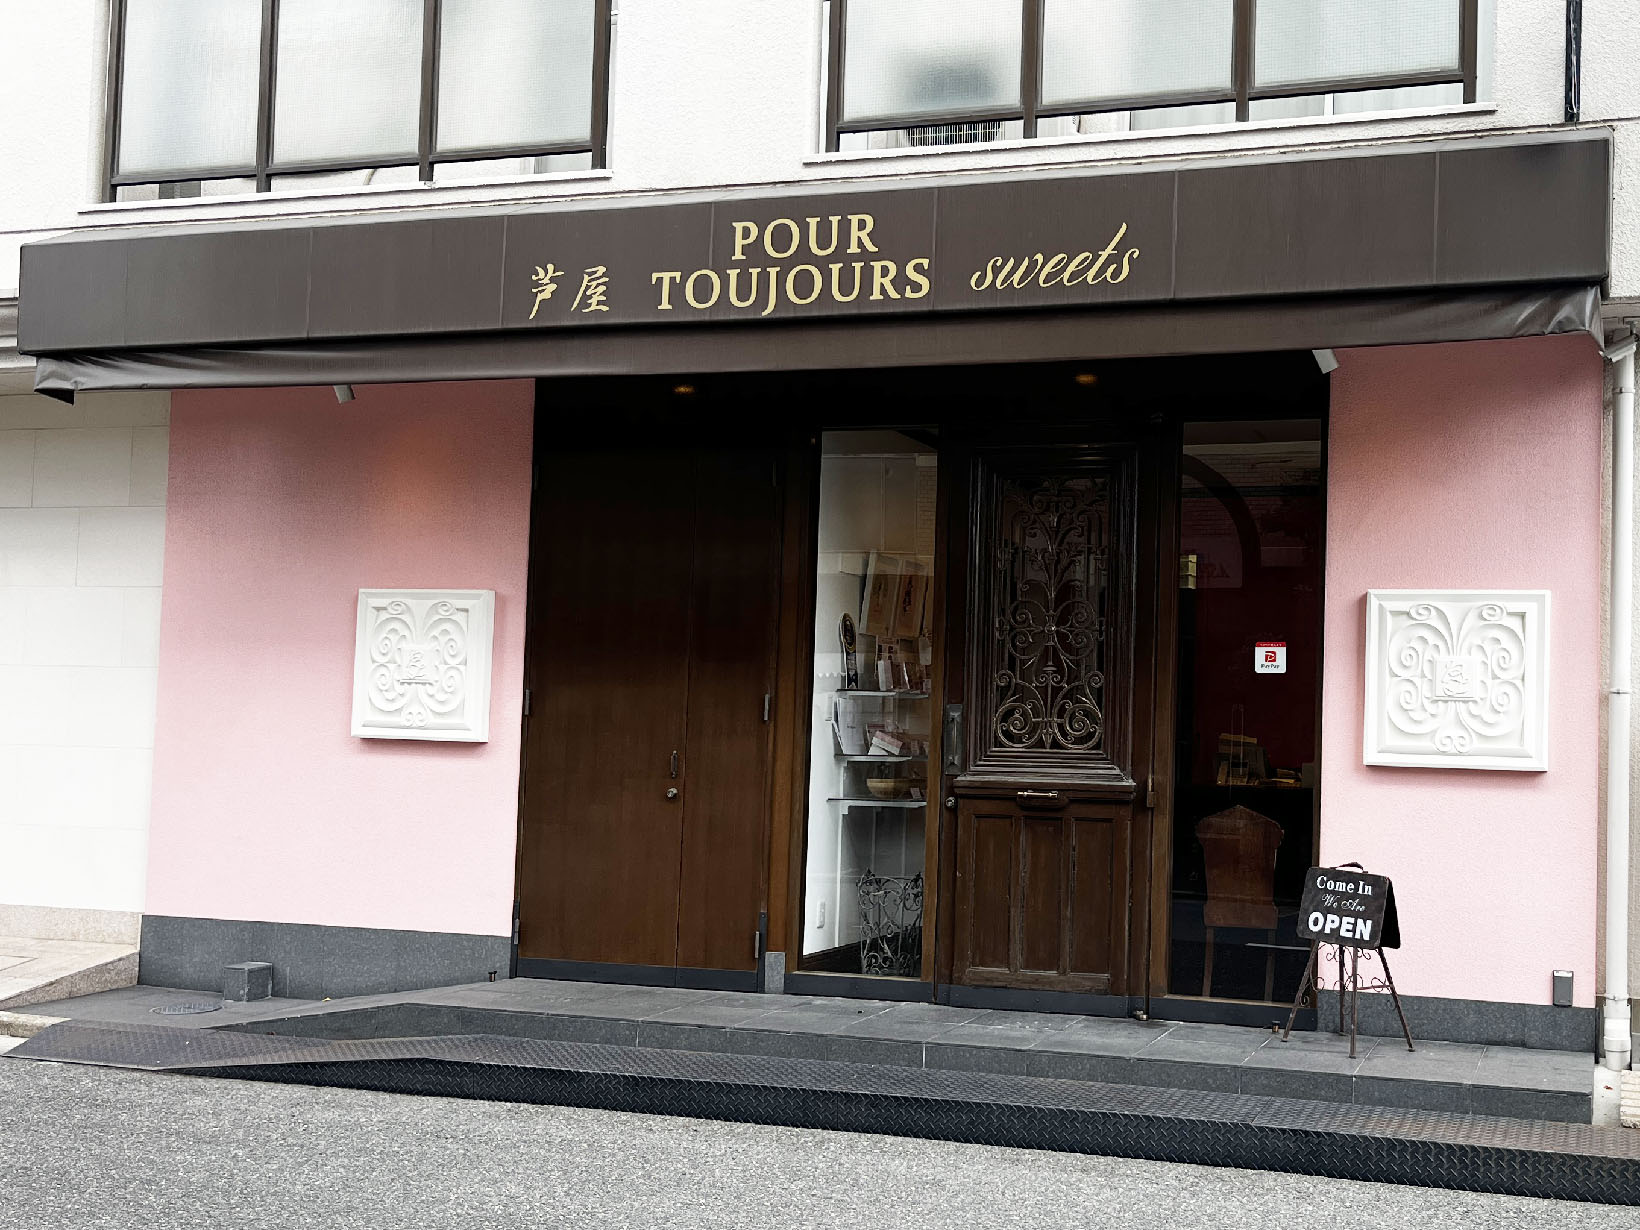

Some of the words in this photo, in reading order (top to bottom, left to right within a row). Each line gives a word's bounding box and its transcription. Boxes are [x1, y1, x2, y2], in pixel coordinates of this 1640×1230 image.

[731, 213, 879, 261] POUR
[970, 222, 1140, 291] sweets
[528, 263, 611, 319] 芦屋
[651, 258, 931, 316] TOUJOURS
[1317, 876, 1355, 893] Come
[1357, 881, 1372, 895] In
[1322, 894, 1340, 908] We
[1341, 899, 1365, 911] Are
[1308, 911, 1373, 941] OPEN
